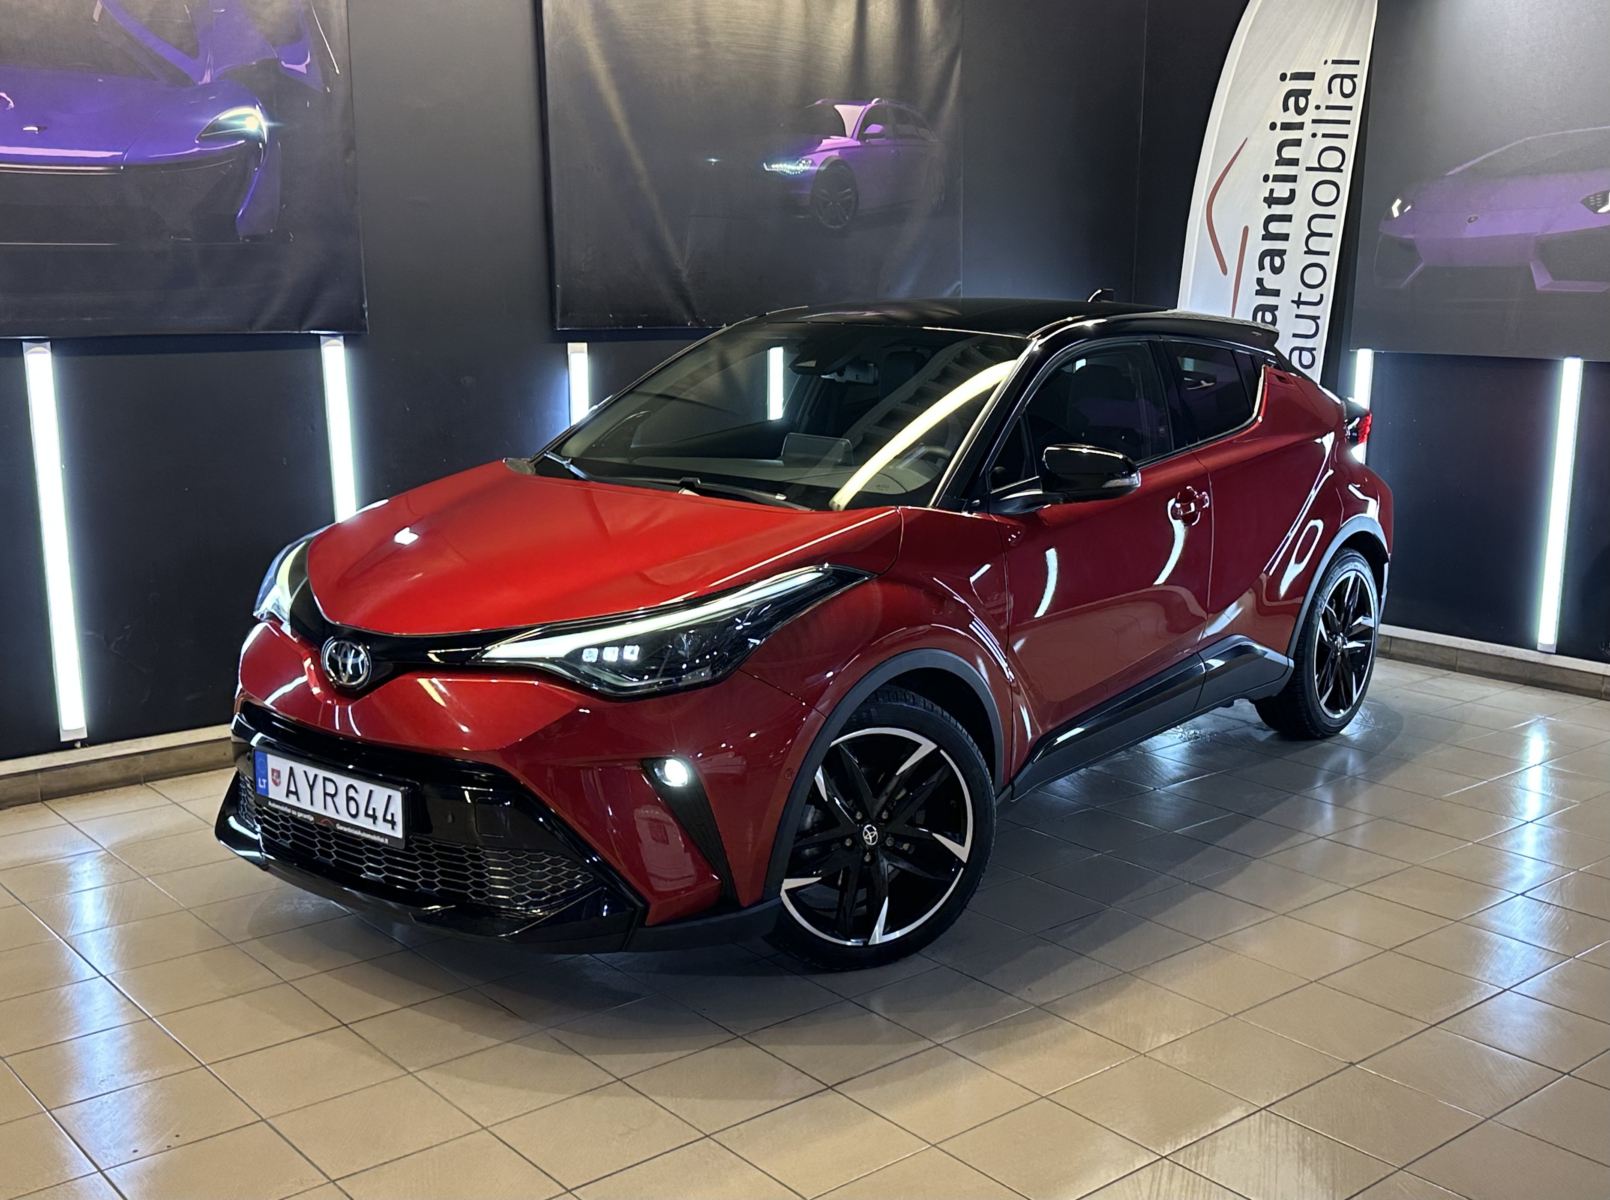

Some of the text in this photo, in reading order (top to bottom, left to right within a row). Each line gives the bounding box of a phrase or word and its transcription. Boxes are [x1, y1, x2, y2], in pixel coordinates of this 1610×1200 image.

[1252, 72, 1316, 327] arantiniai
[1289, 59, 1360, 370] automobiliai
[258, 777, 267, 789] LT
